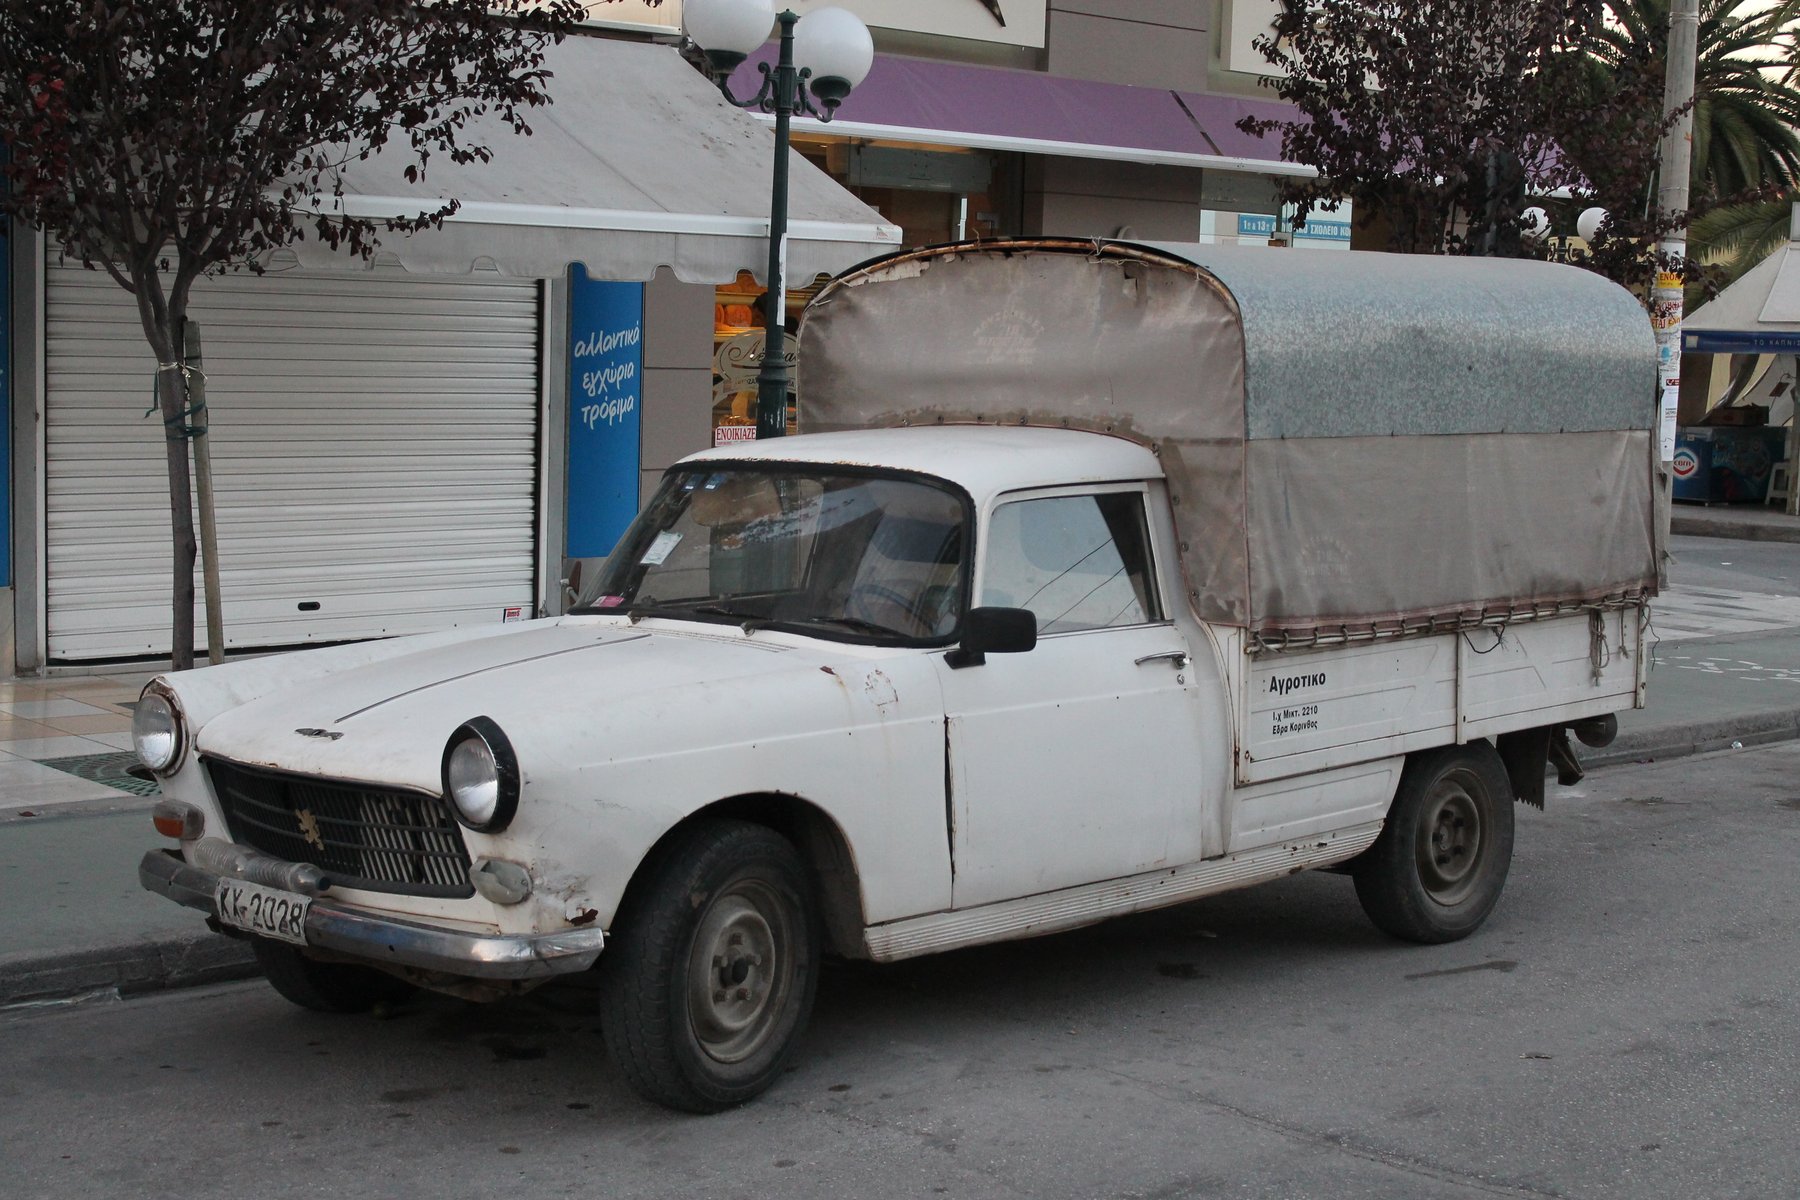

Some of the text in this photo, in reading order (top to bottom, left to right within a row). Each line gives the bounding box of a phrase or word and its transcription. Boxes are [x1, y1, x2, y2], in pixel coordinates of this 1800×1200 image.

[1310, 224, 1338, 236] ΣΧΟΛΕΙΟ
[574, 320, 640, 358] αλλαντικά
[582, 361, 634, 397] εγχώρια
[581, 395, 634, 430] τρόφιμα
[1269, 673, 1326, 695] Αγροτικο
[1302, 705, 1318, 716] 2210
[1272, 720, 1318, 735] Εδρα Κορινθος
